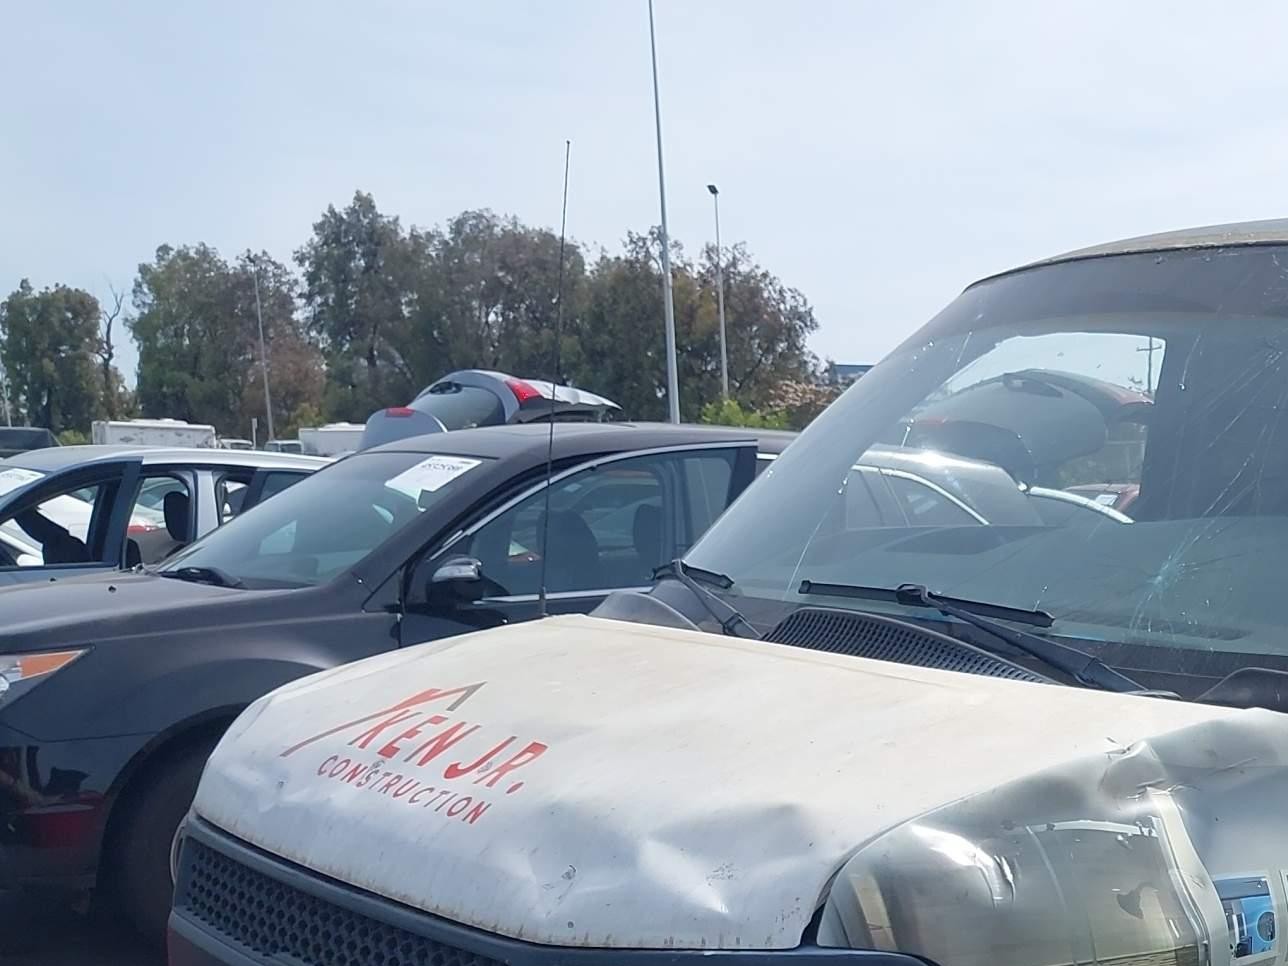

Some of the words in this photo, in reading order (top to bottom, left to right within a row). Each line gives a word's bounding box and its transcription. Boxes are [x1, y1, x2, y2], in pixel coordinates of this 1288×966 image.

[317, 754, 493, 825] CONSTRUCTION
[347, 709, 482, 766] KEN
[443, 735, 549, 794] JR.
